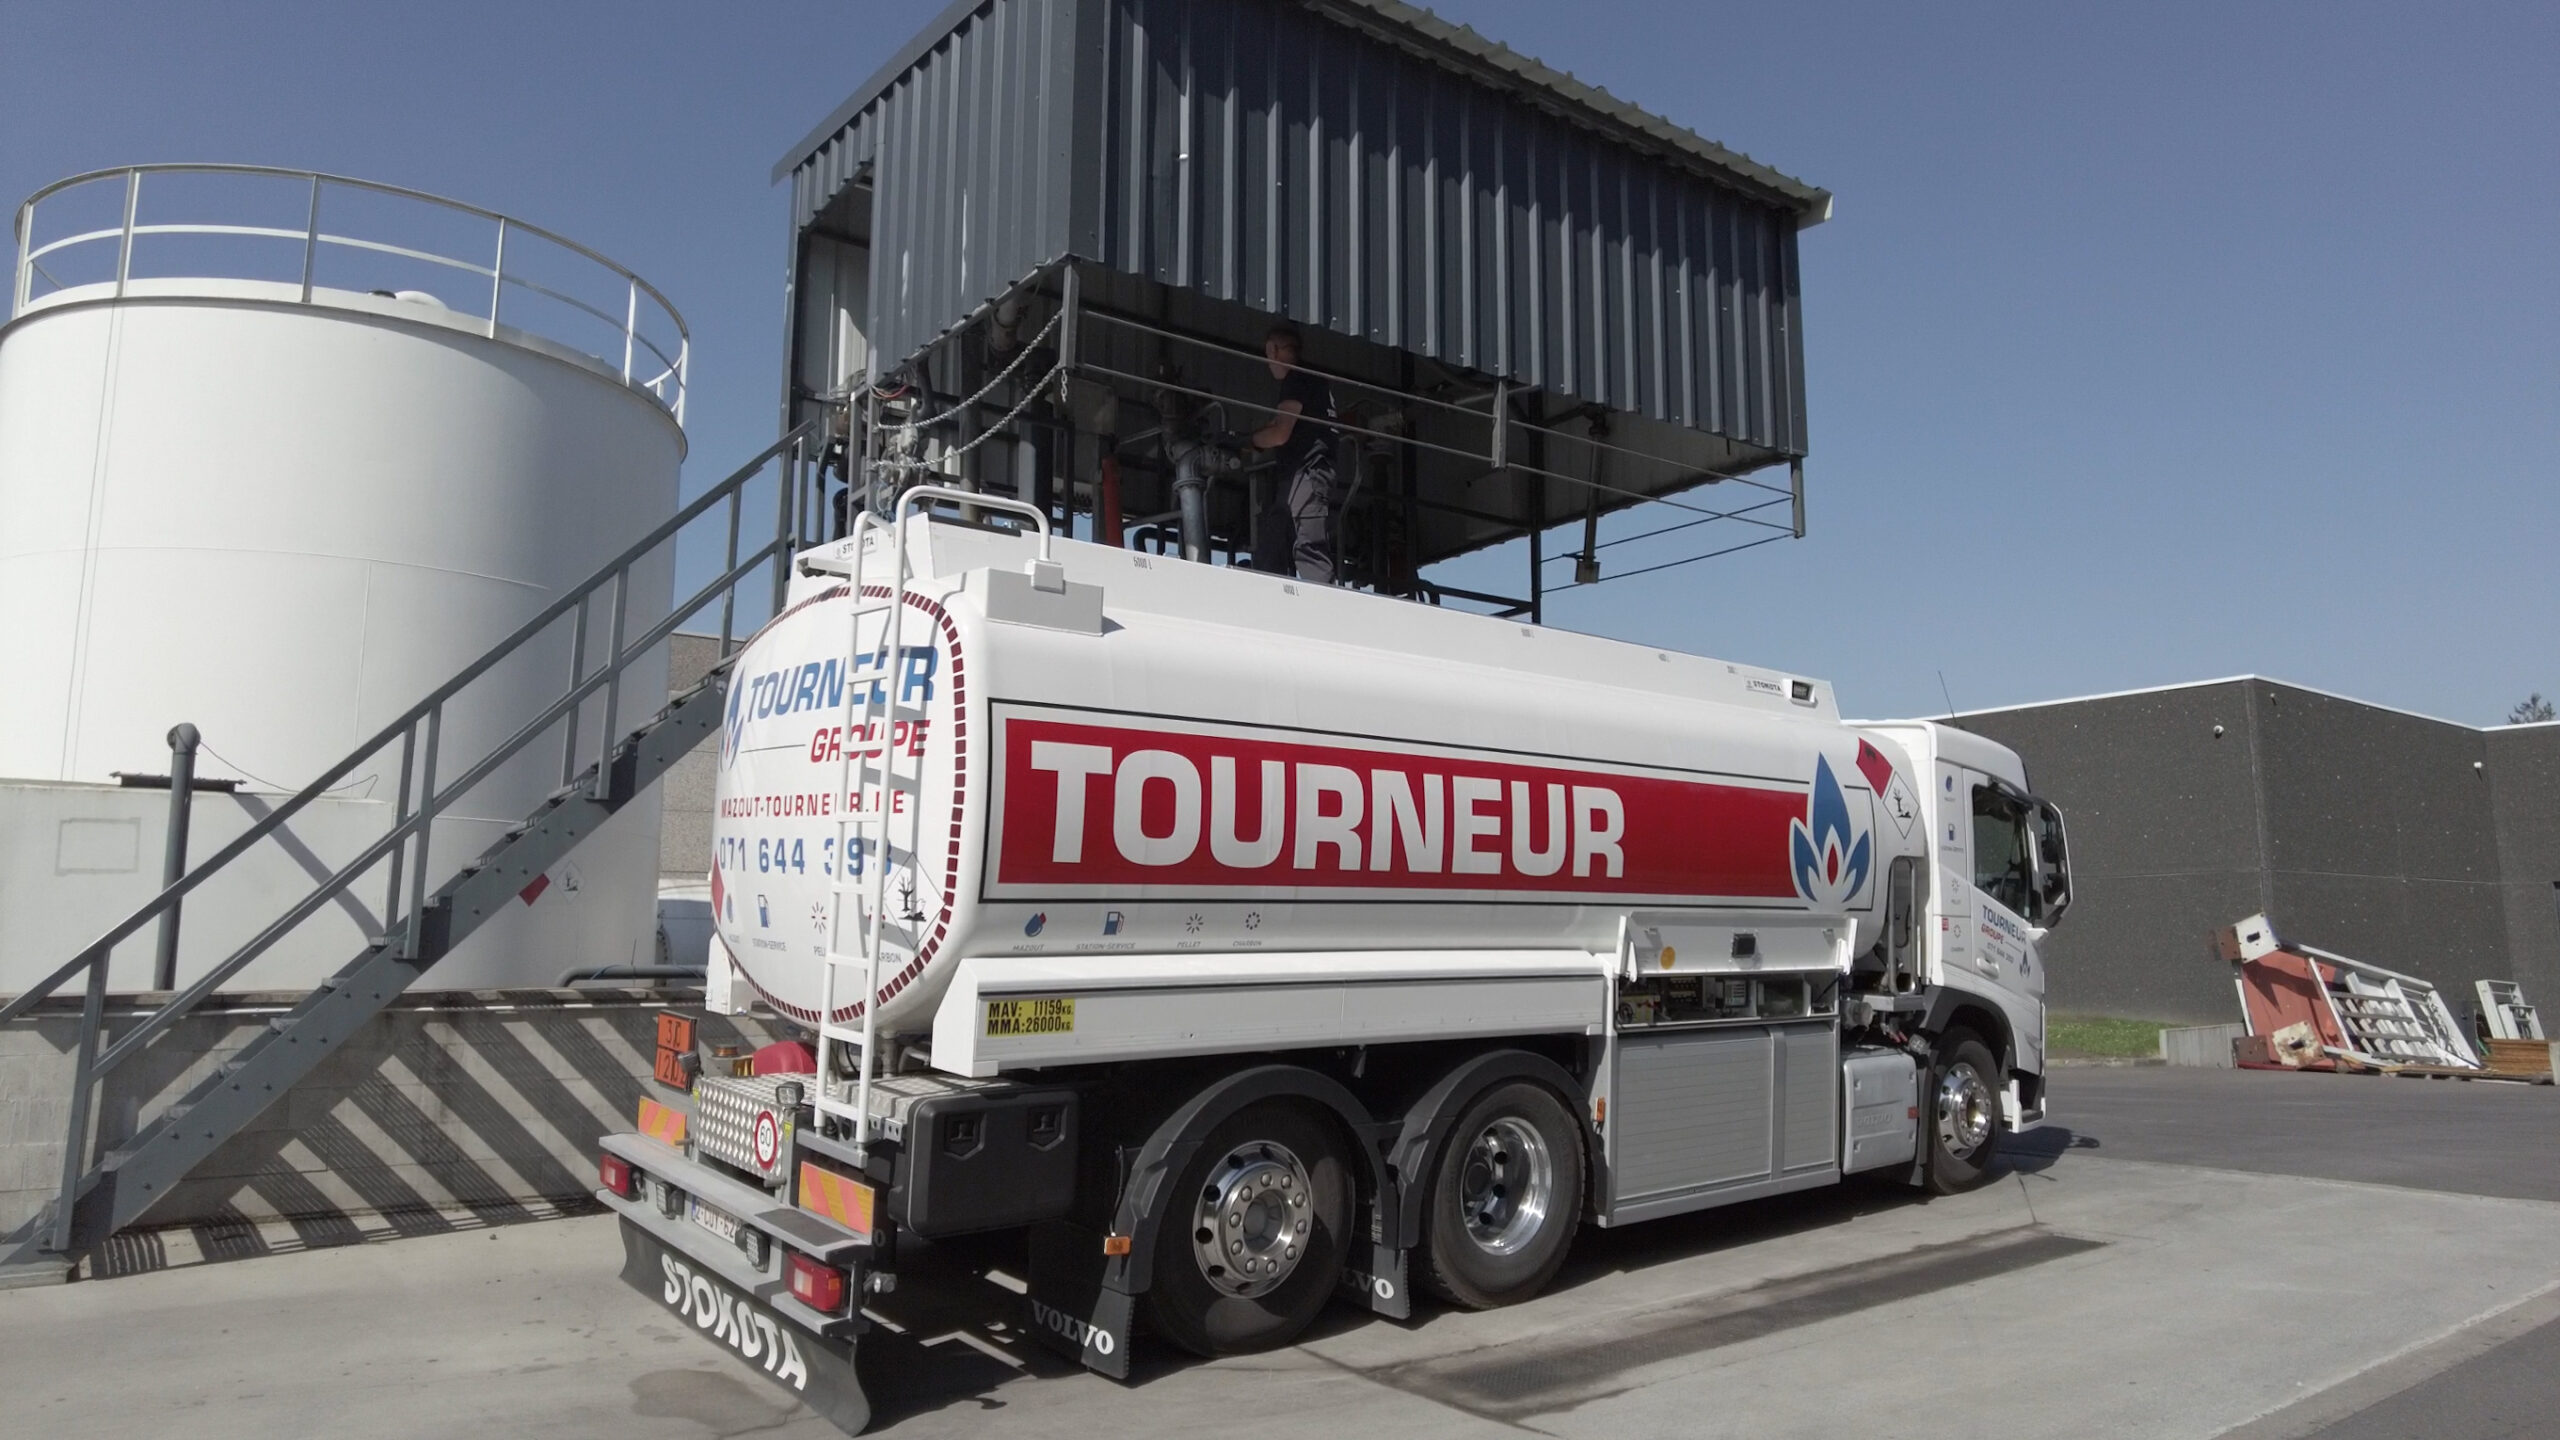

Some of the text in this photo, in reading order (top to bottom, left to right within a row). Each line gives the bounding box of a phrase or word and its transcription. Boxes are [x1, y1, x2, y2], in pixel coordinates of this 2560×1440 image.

[843, 535, 874, 554] STTA
[721, 790, 905, 818] MAZOUT-TOURNER.E
[1031, 740, 1626, 879] TOURNEUR
[720, 836, 746, 872] 071
[759, 837, 805, 875] 644
[1981, 923, 2004, 944] GROUPE
[1982, 904, 2027, 945] TOURNEUR
[989, 1001, 1022, 1018] MAV:
[759, 1126, 772, 1148] 60
[661, 1253, 808, 1391] STOKOTA
[1032, 1301, 1115, 1356] VOLVO
